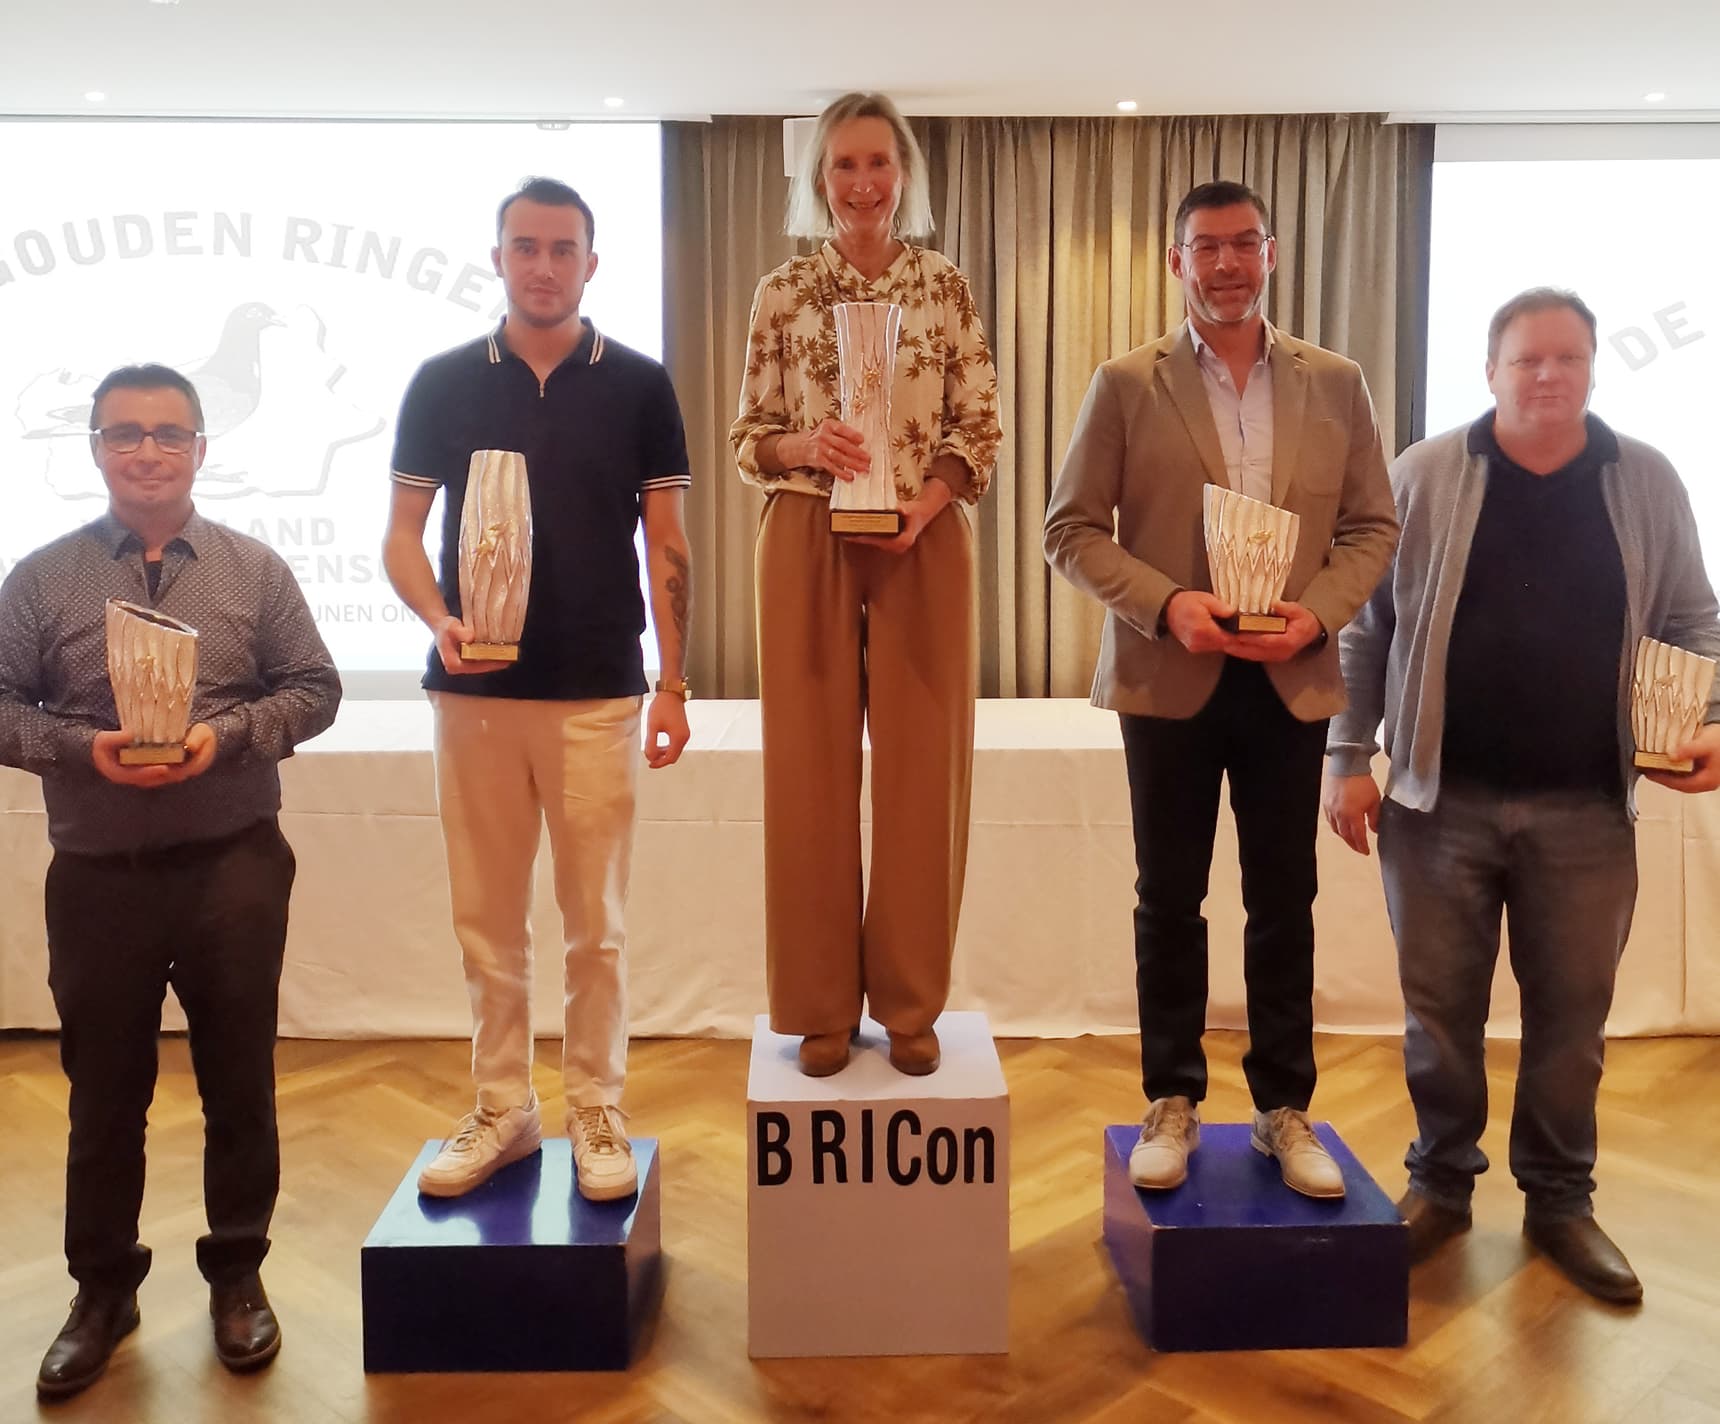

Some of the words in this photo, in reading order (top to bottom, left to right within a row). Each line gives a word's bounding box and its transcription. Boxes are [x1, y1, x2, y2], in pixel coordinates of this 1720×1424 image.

[282, 215, 508, 321] RINGE
[1607, 300, 1706, 371] DE
[248, 516, 336, 547] AND
[381, 603, 417, 623] ON
